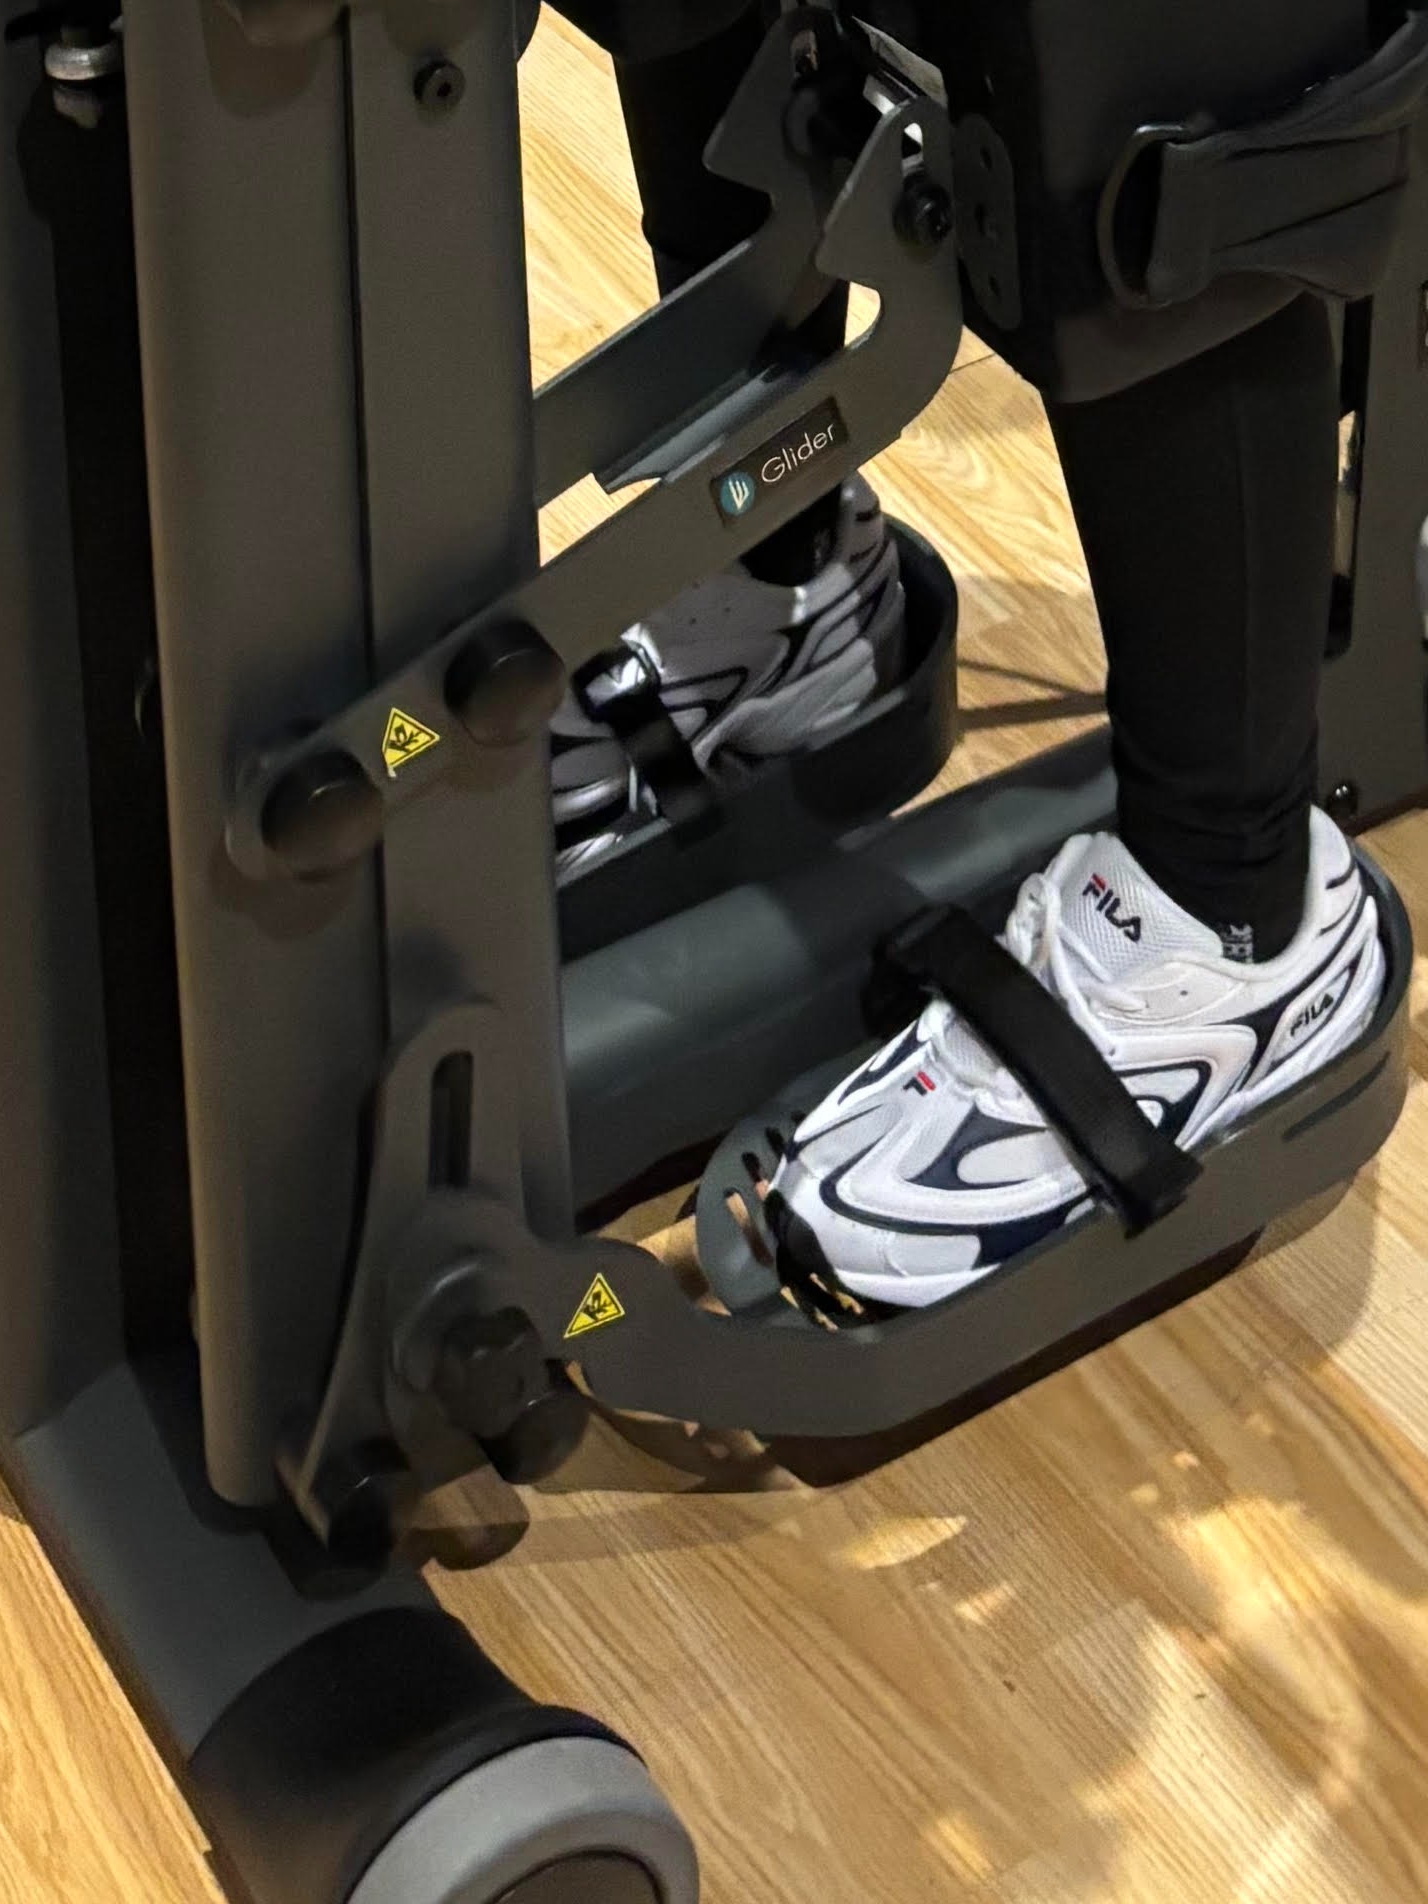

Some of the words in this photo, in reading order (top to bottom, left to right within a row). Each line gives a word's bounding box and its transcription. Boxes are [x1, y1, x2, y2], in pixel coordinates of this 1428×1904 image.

[761, 423, 834, 483] Glider
[1081, 873, 1142, 944] FILA
[1290, 992, 1334, 1038] FILA
